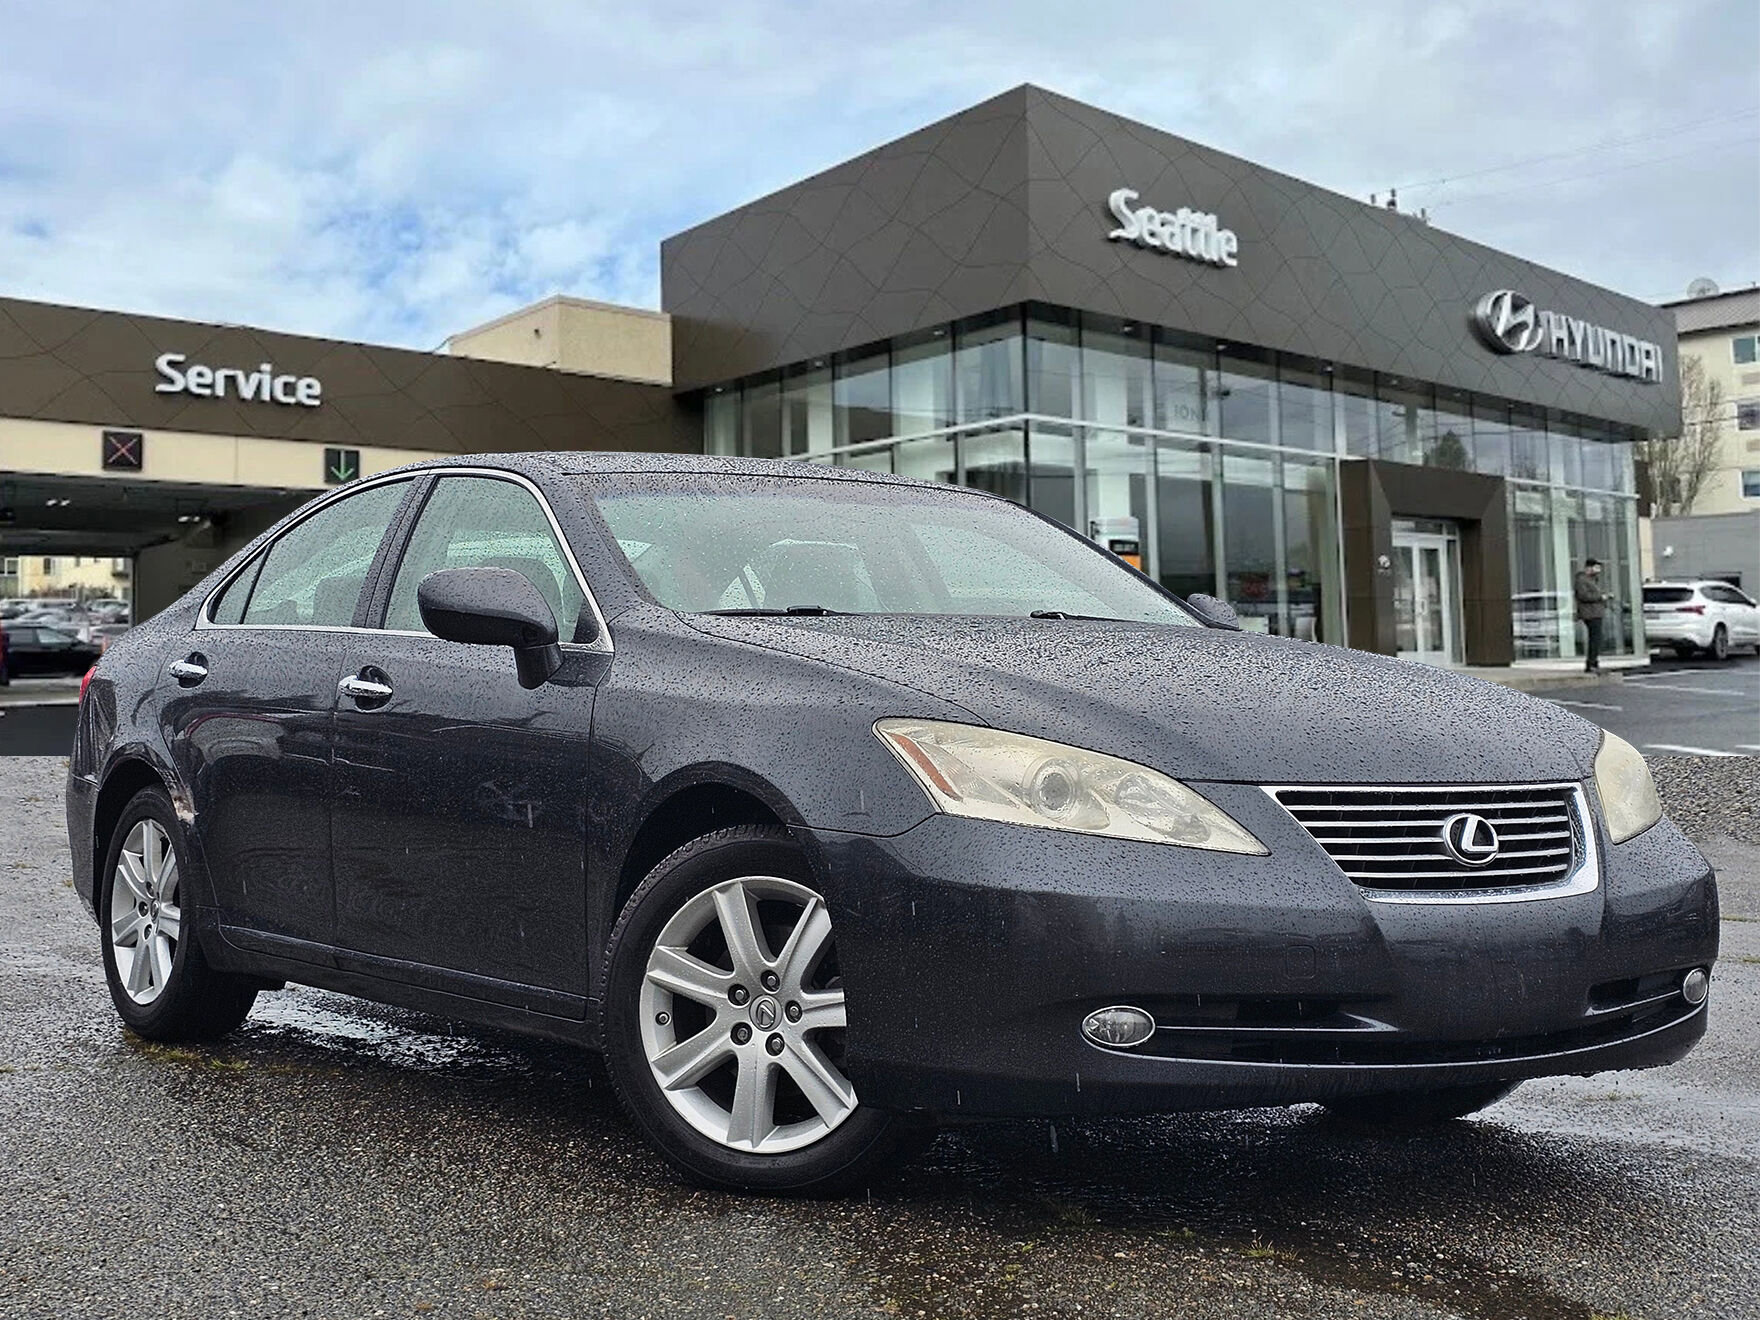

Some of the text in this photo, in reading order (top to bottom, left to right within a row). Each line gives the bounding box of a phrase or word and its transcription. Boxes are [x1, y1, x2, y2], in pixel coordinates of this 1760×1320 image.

[1109, 188, 1238, 267] Seattle
[155, 353, 322, 406] Service
[1541, 310, 1662, 383] HYUNDAI
